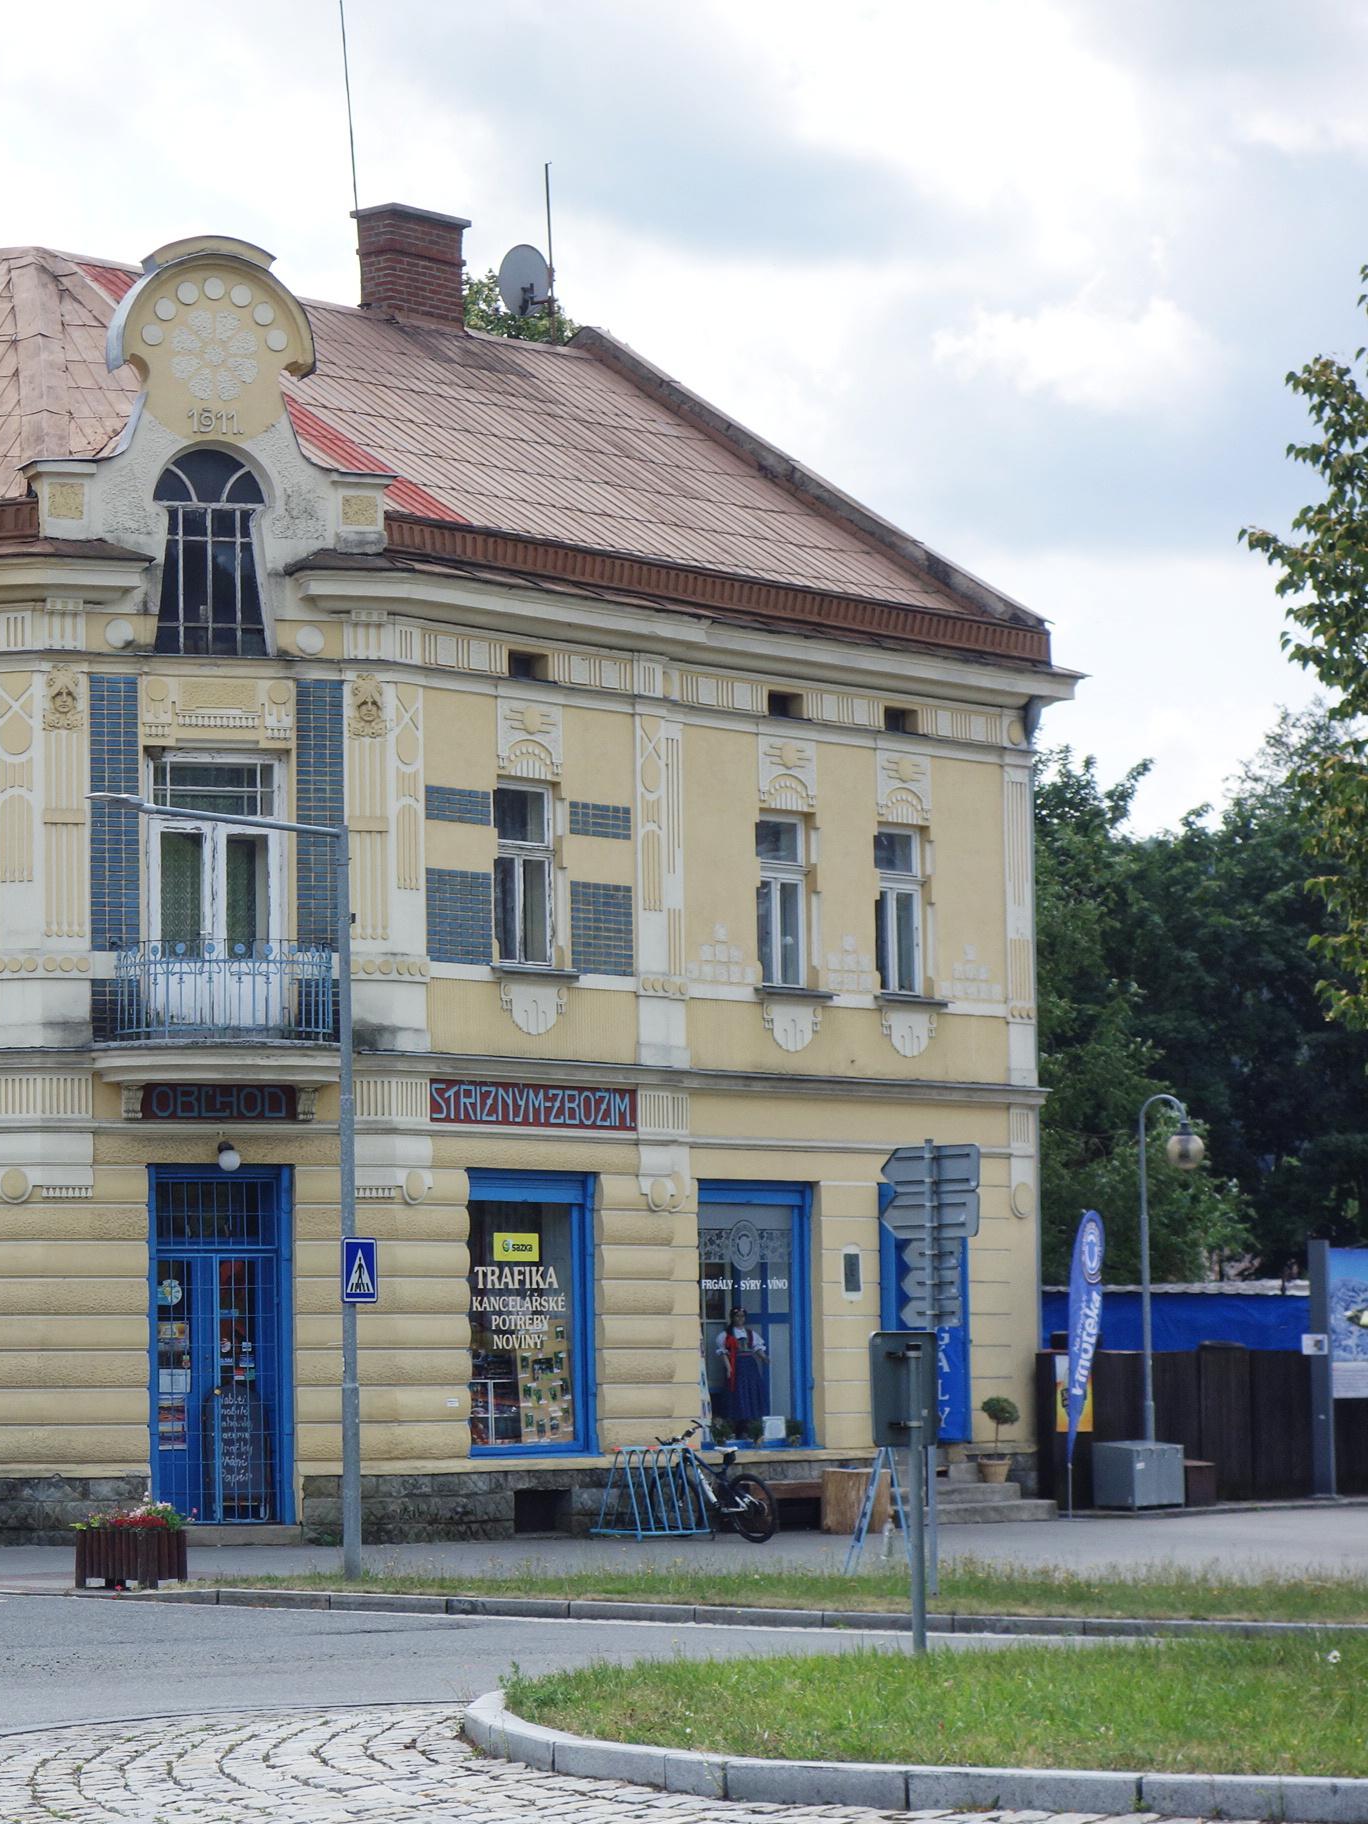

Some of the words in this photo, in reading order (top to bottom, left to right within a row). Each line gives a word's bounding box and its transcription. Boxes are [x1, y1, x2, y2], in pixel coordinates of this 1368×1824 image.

[151, 1086, 286, 1117] OBCHOD
[474, 1266, 559, 1289] TRAFIKA
[701, 1277, 733, 1290] FRGÁLY
[740, 1277, 761, 1290] SÝRY
[768, 1277, 788, 1290] VÍNO
[472, 1291, 566, 1311] KANCELÁŘSKÉ
[492, 1312, 550, 1330] POTŘEBY
[493, 1334, 543, 1349] NOVINY
